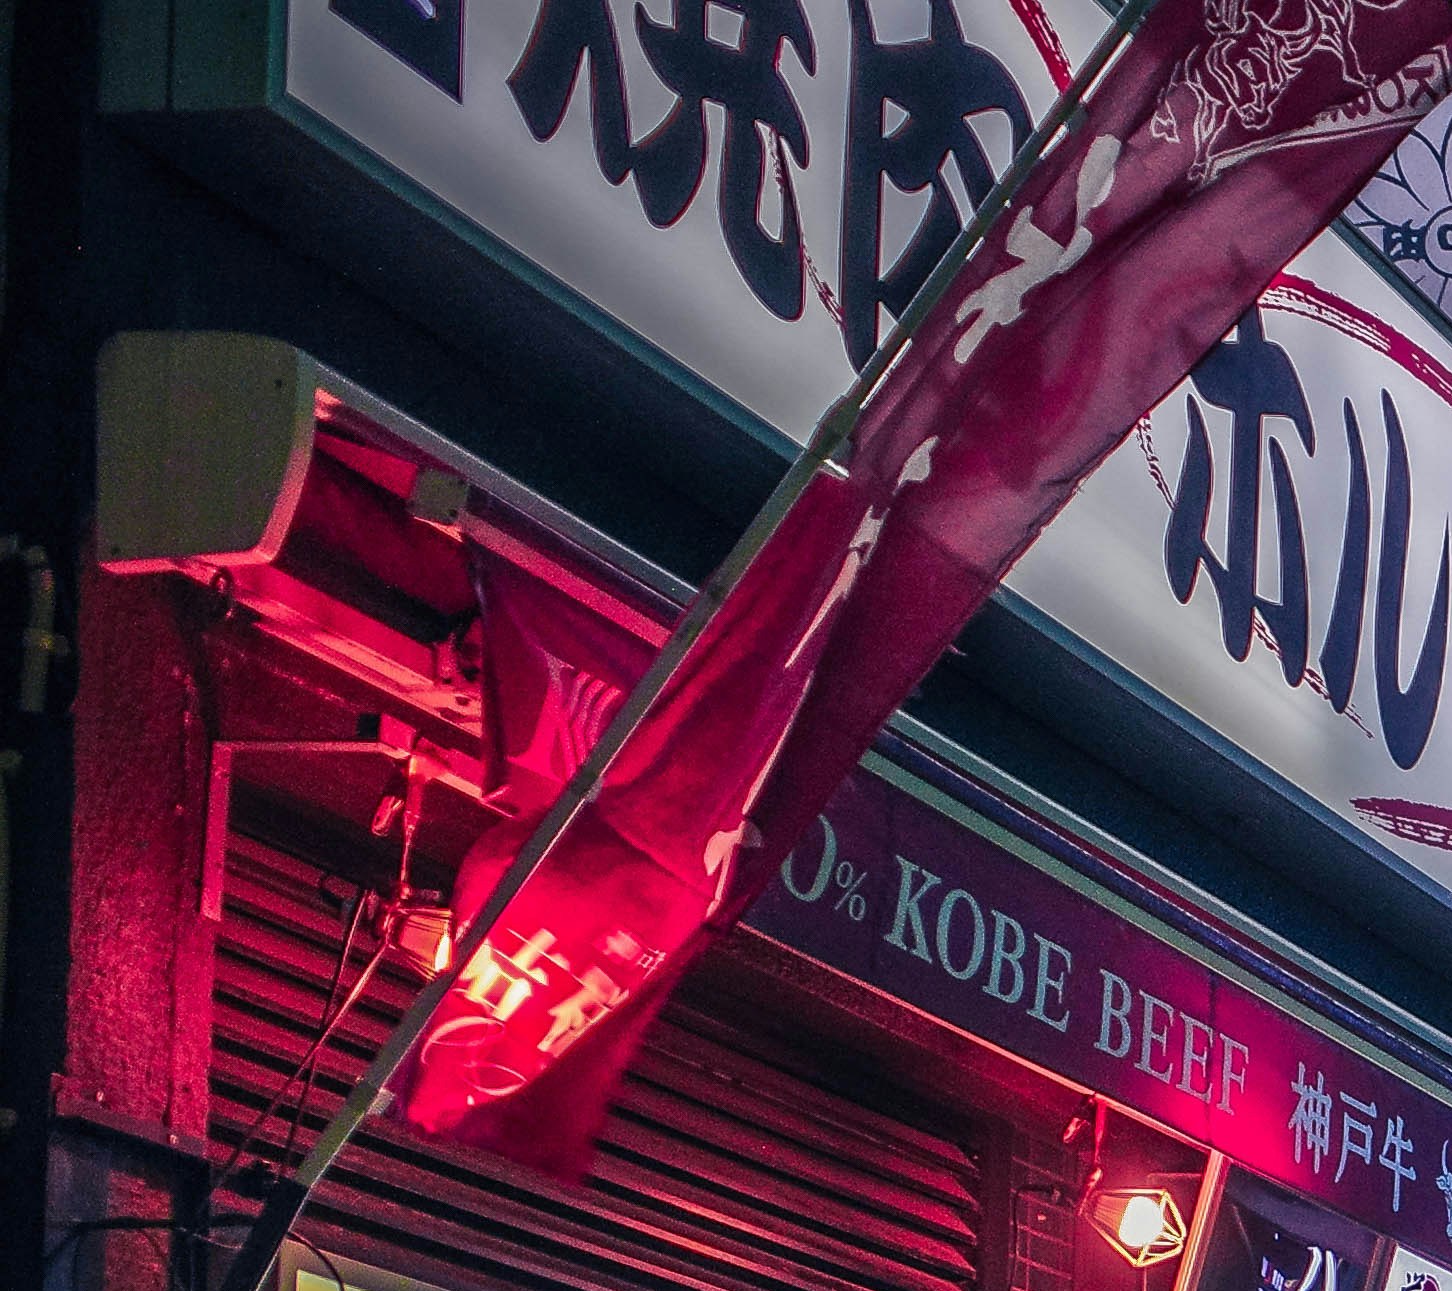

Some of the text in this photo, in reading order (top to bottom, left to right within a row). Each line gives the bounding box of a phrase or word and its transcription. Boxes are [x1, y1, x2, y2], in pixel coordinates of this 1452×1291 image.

[882, 854, 1074, 1033] KOBE
[1093, 967, 1249, 1117] BEEF
[1288, 1062, 1417, 1212] 神戸牛
